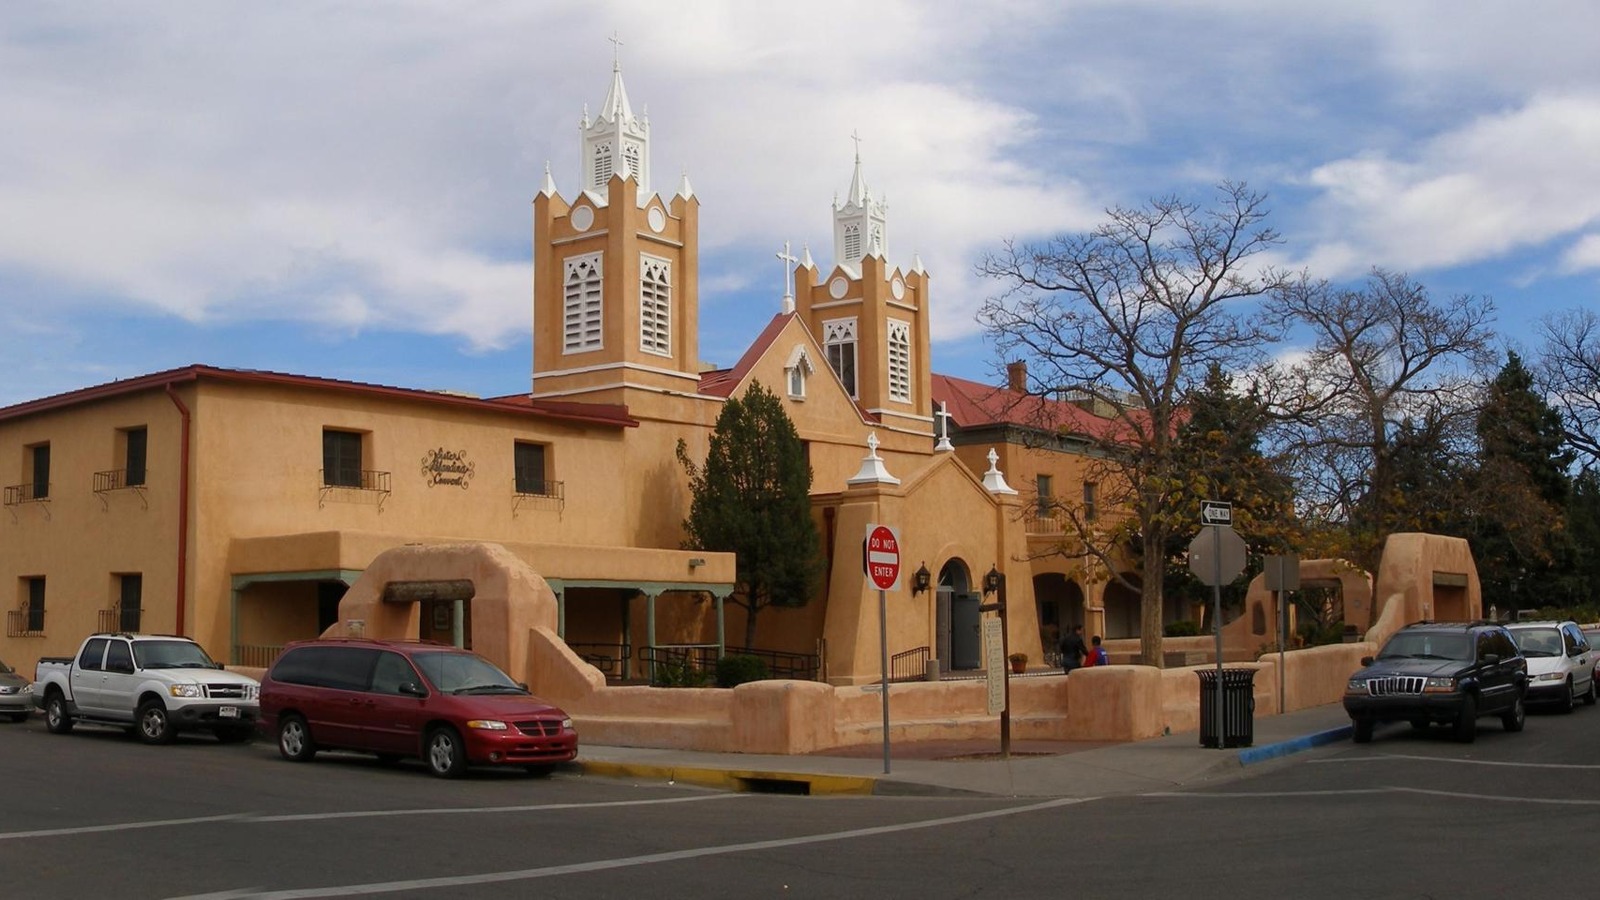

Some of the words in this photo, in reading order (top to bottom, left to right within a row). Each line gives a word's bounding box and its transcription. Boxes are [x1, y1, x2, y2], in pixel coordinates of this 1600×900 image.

[434, 472, 463, 486] Convent
[1208, 508, 1219, 518] ONE
[1219, 509, 1230, 519] WAY
[871, 537, 880, 549] DO
[883, 539, 895, 550] NOT
[874, 566, 894, 577] ENTER
